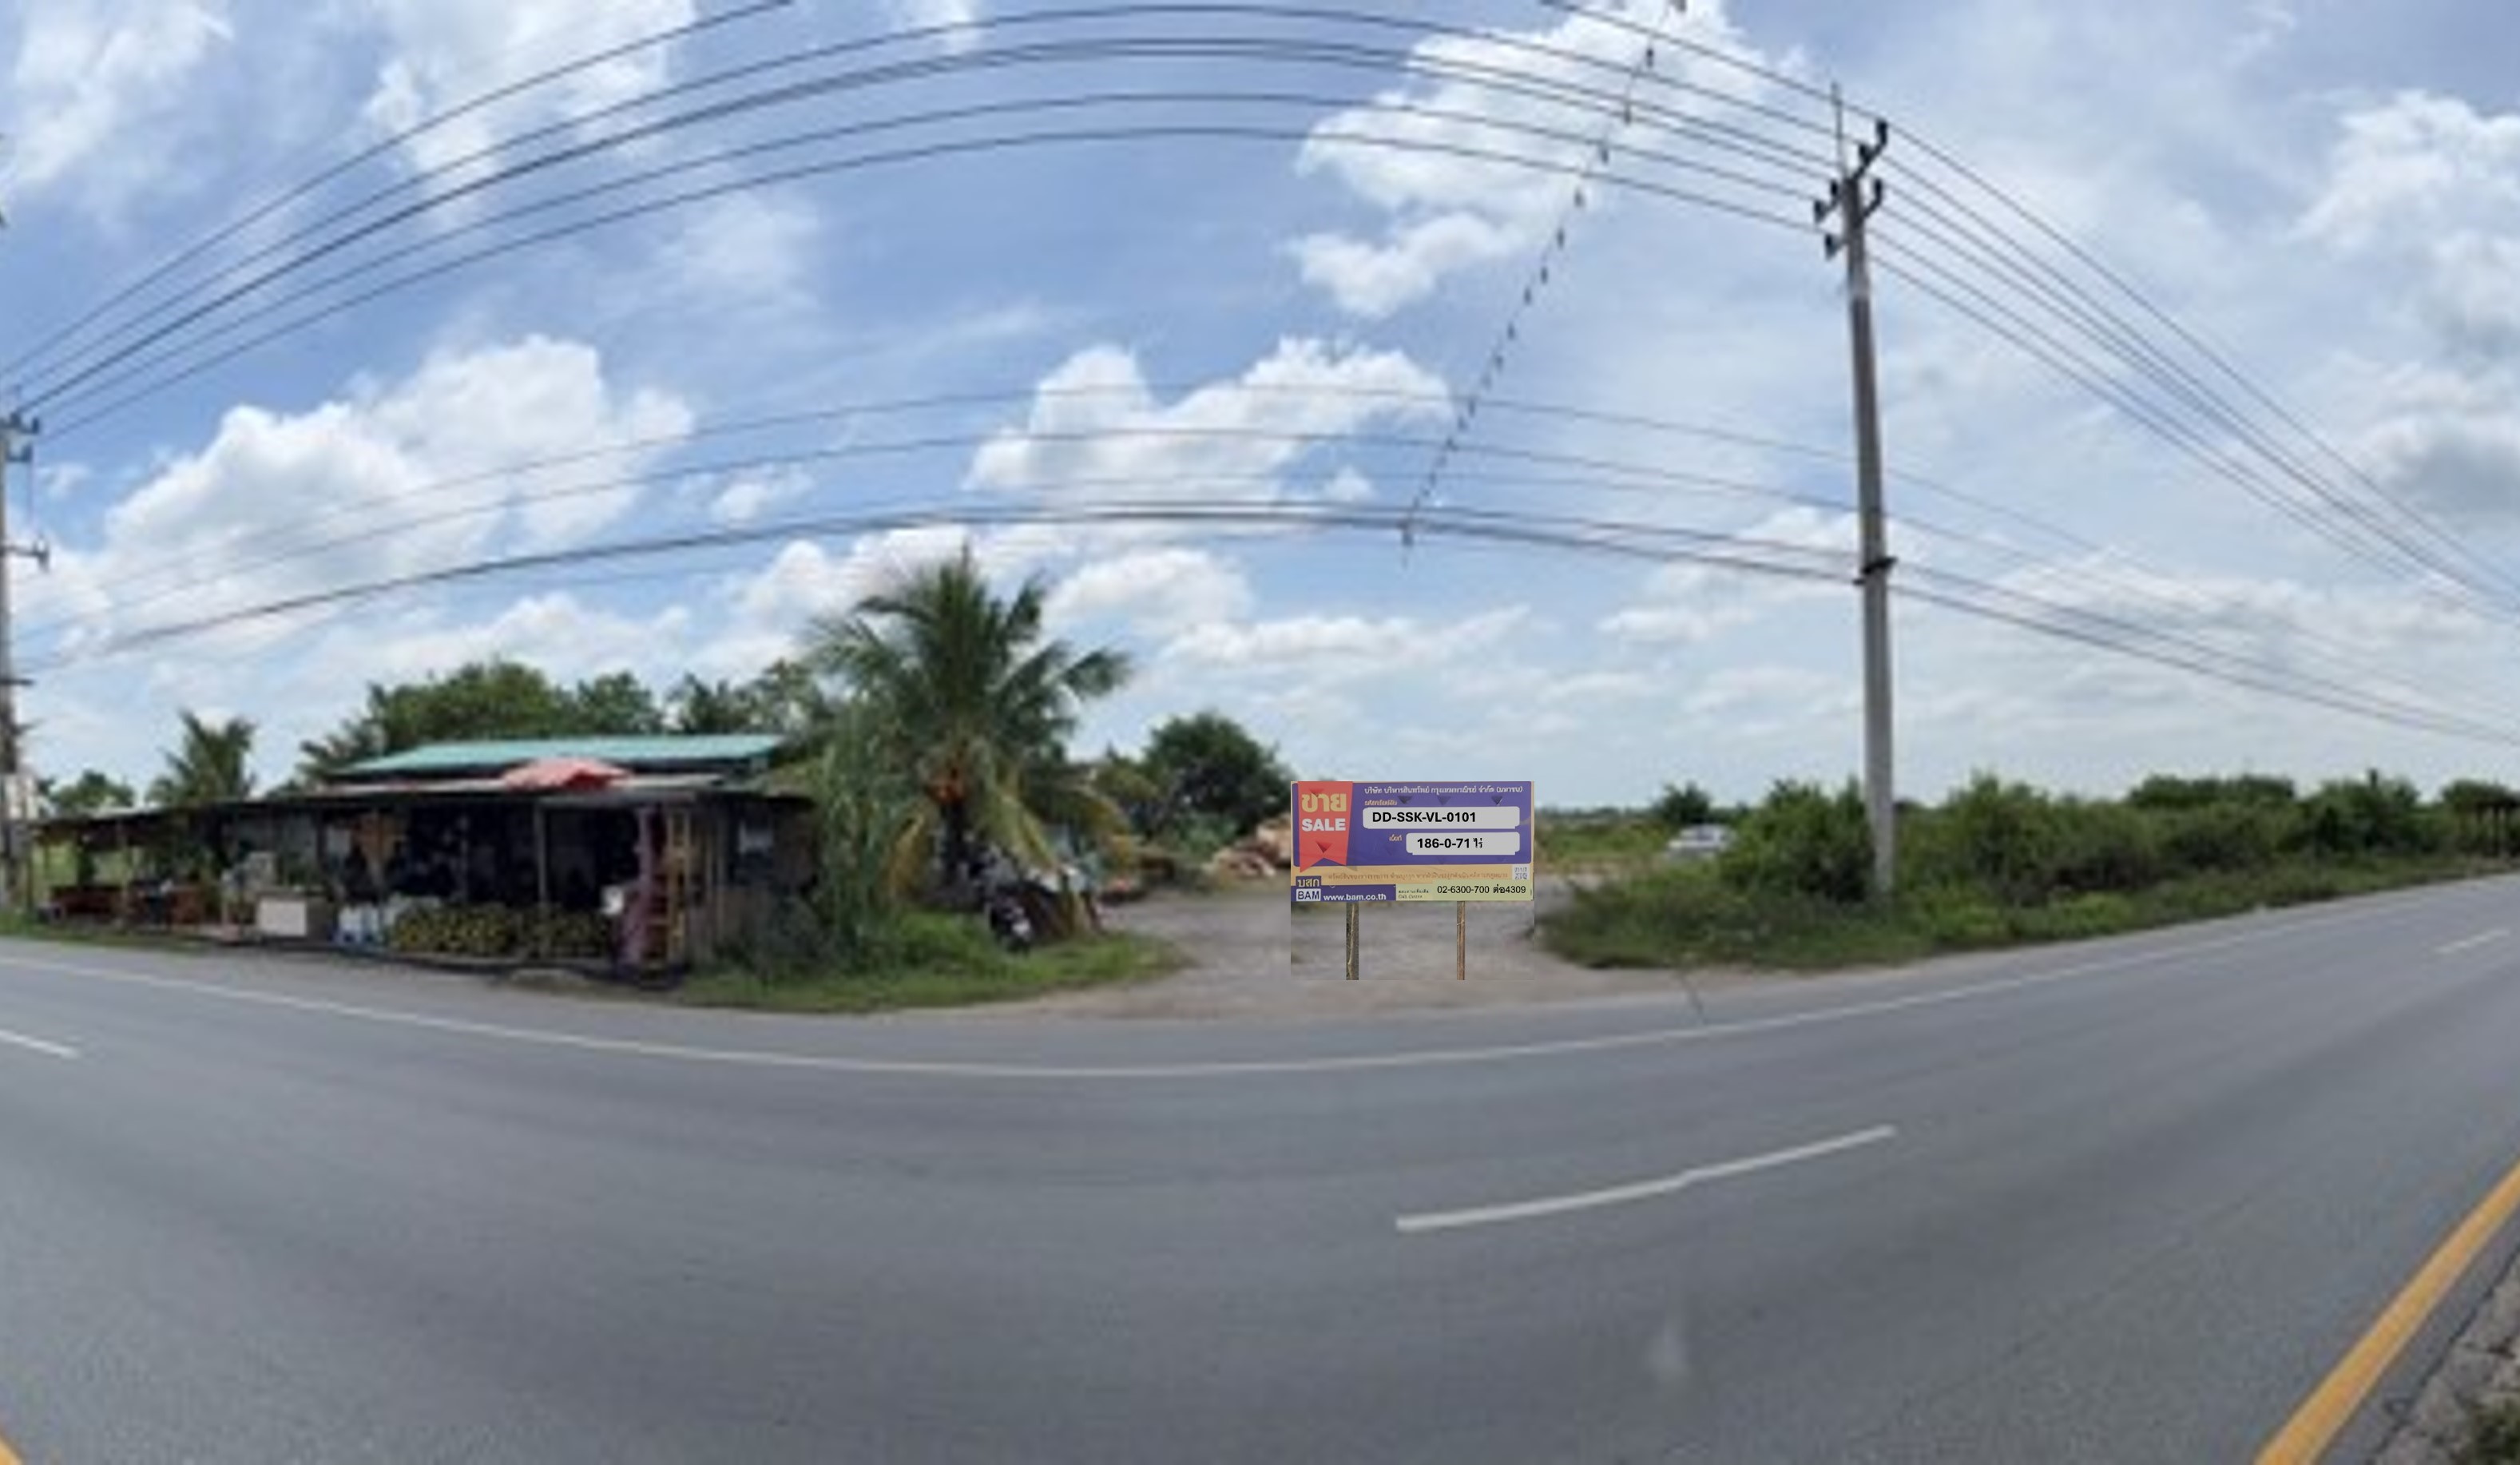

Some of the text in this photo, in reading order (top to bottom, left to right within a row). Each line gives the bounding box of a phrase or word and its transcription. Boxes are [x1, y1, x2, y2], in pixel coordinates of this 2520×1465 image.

[1301, 792, 1347, 812] ขาย
[1372, 812, 1476, 823] DD-SSK-VL-0101
[1301, 818, 1346, 832] SALE
[1417, 838, 1470, 848] 186-0-71
[1297, 878, 1320, 887] บสก
[1437, 885, 1490, 894] 02-6300-700
[1493, 883, 1526, 894] ต่อ4309
[1297, 891, 1320, 900] BAM
[1323, 893, 1387, 902] www.bam.co.th
